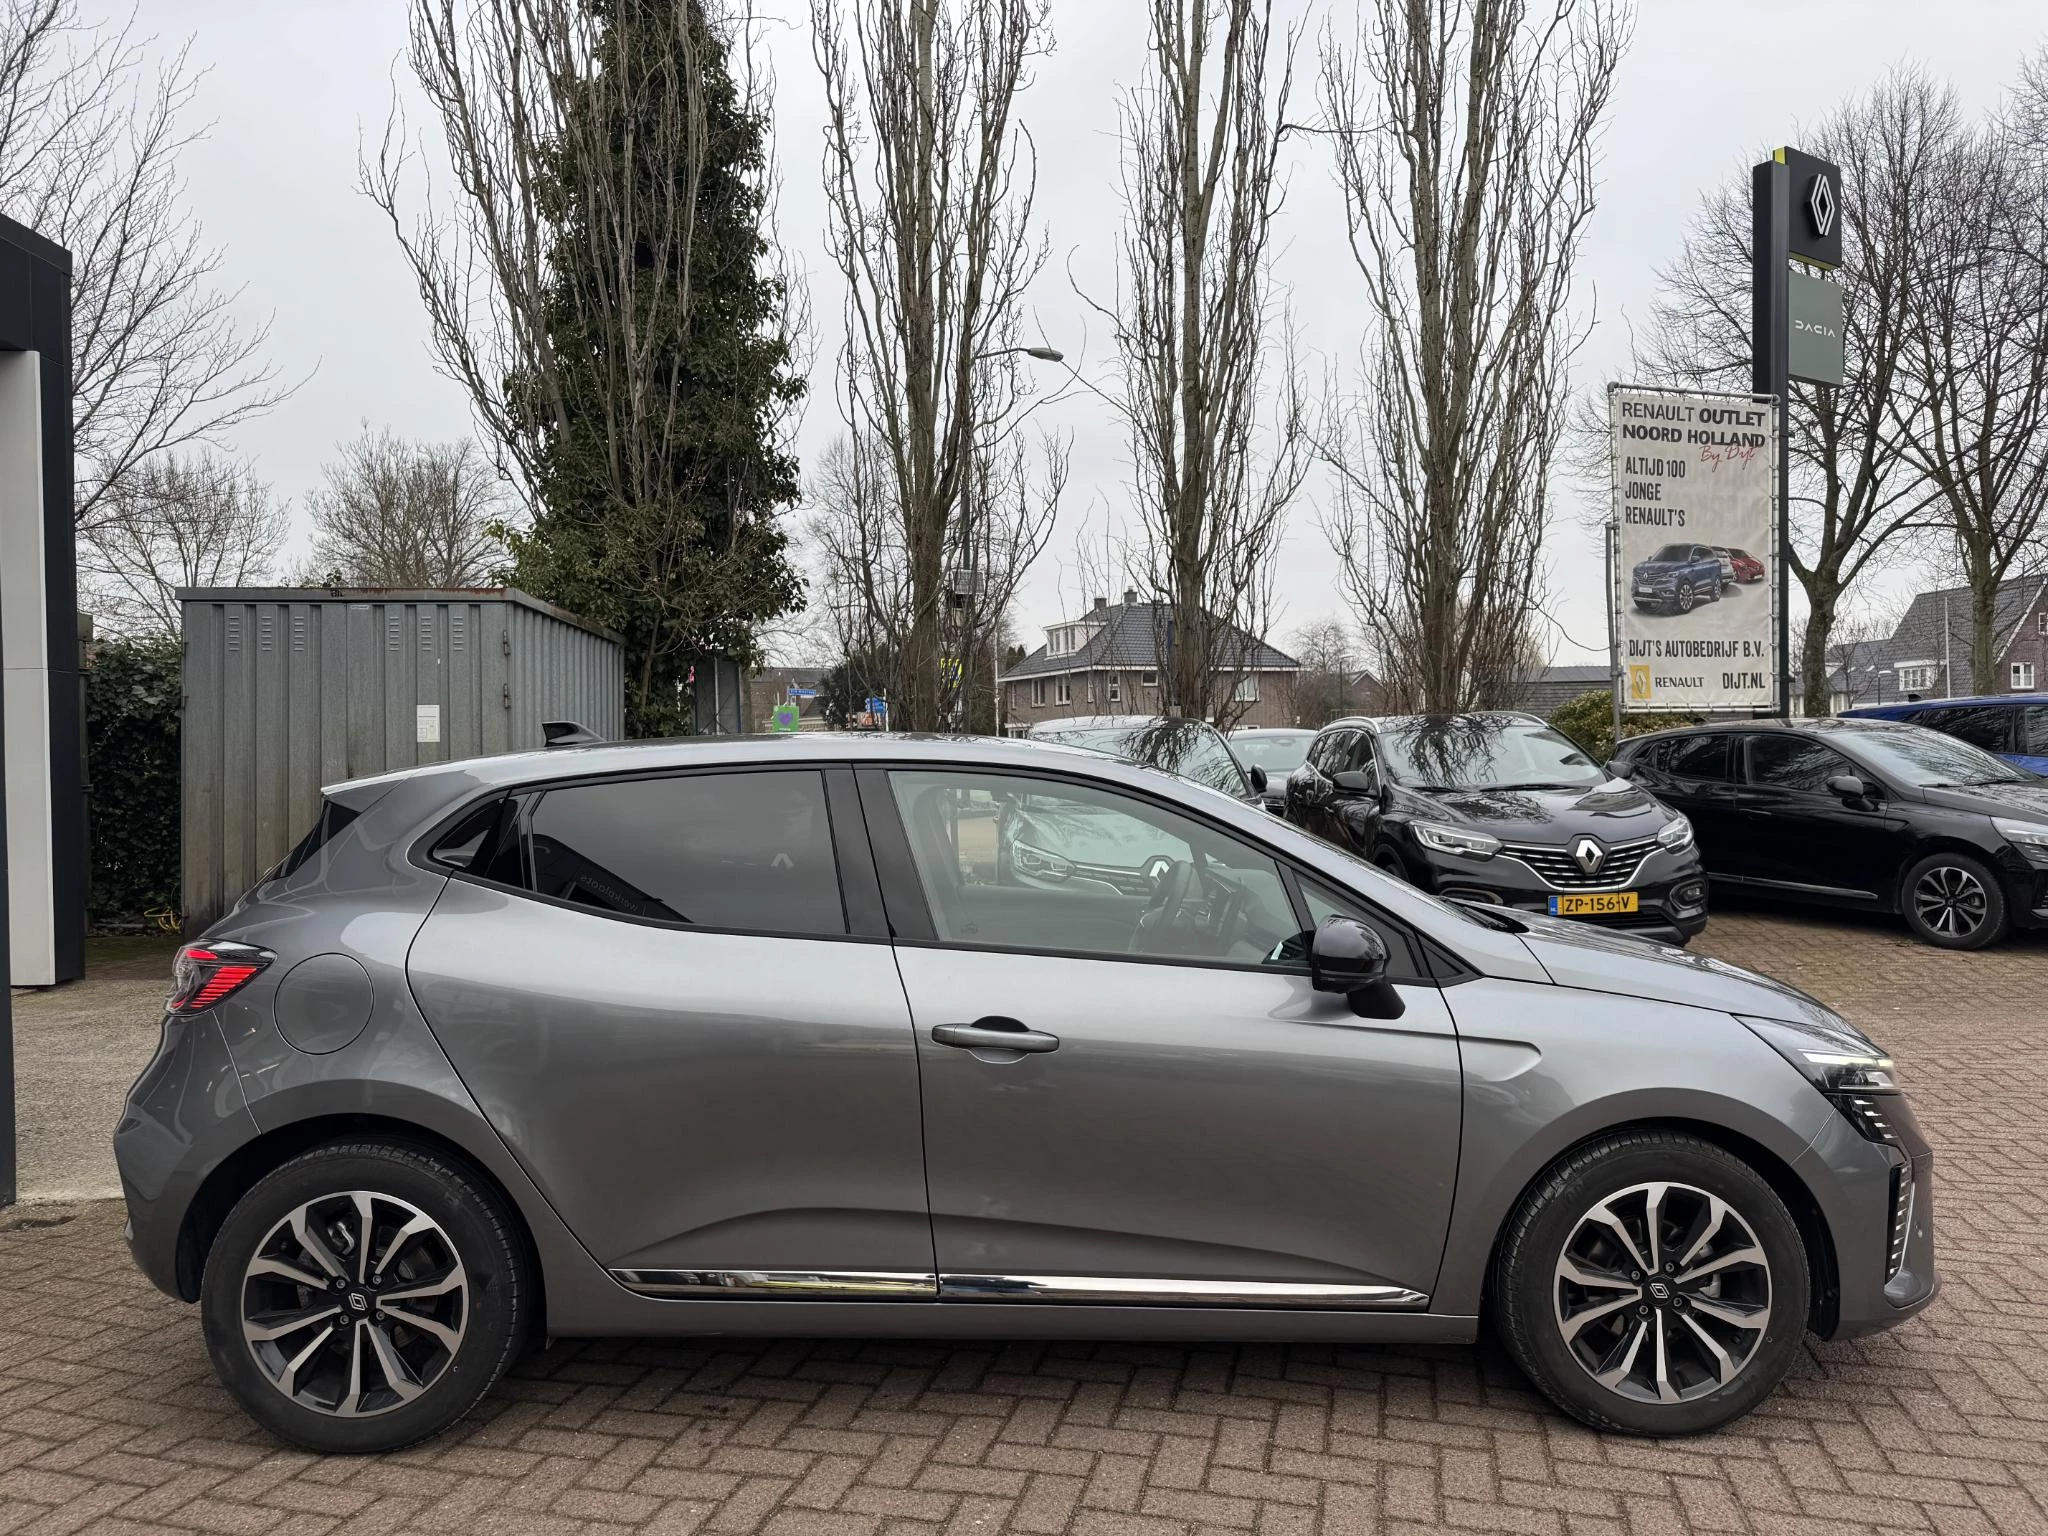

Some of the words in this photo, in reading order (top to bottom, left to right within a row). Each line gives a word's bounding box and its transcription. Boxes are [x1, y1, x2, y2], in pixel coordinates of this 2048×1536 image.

[1795, 320, 1836, 338] DACIA
[1622, 402, 1694, 423] RENAULT
[1699, 408, 1766, 427] OUTLET
[1622, 424, 1682, 443] NOORD
[1687, 429, 1766, 448] HOLLAND
[1625, 456, 1664, 476] ALTIJD
[1666, 460, 1686, 478] 100
[1699, 445, 1722, 472] By
[1625, 481, 1662, 501] JONGE
[1625, 506, 1686, 527] RENAULT'S
[1629, 639, 1662, 657] DIJT'S
[1665, 640, 1739, 658] AUTOBEDRIJF
[1743, 640, 1765, 657] B.V.
[1655, 677, 1704, 688] RENAULT
[1722, 672, 1766, 689] DIJT.NL
[1565, 896, 1630, 912] ZP-156-V
